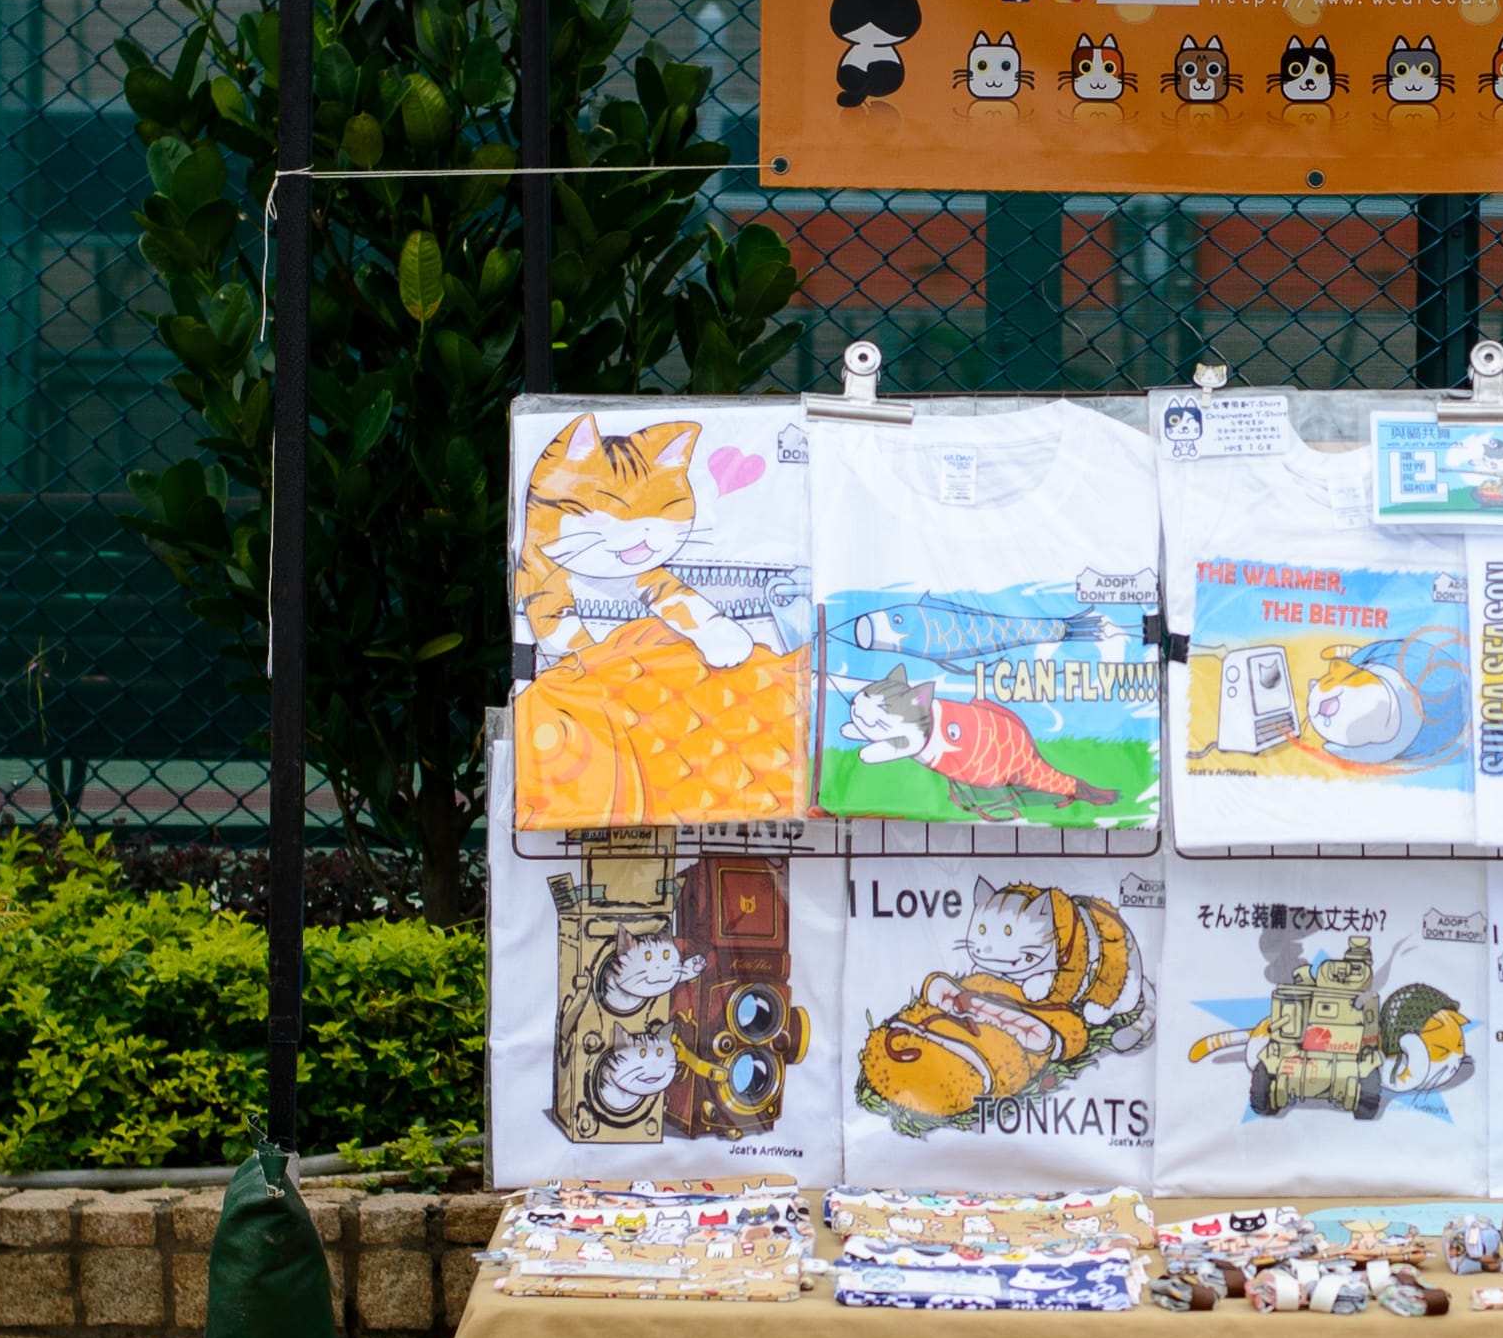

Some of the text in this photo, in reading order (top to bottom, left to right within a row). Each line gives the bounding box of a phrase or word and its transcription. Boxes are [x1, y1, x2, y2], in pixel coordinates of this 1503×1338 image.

[1095, 577, 1138, 588] ADOPT,
[1197, 562, 1346, 595] THE WARMER,
[1080, 591, 1156, 602] DON'T SHOP!
[1262, 600, 1388, 629] THE BETTER
[975, 660, 986, 701] I
[992, 659, 1057, 703] CAN
[849, 879, 962, 919] I Love
[1197, 902, 1387, 933] そんな装備で大丈夫か?
[1493, 924, 1499, 944] I
[973, 1095, 1149, 1138] TONKATS
[729, 1144, 803, 1158] Jcat's ArtWorks
